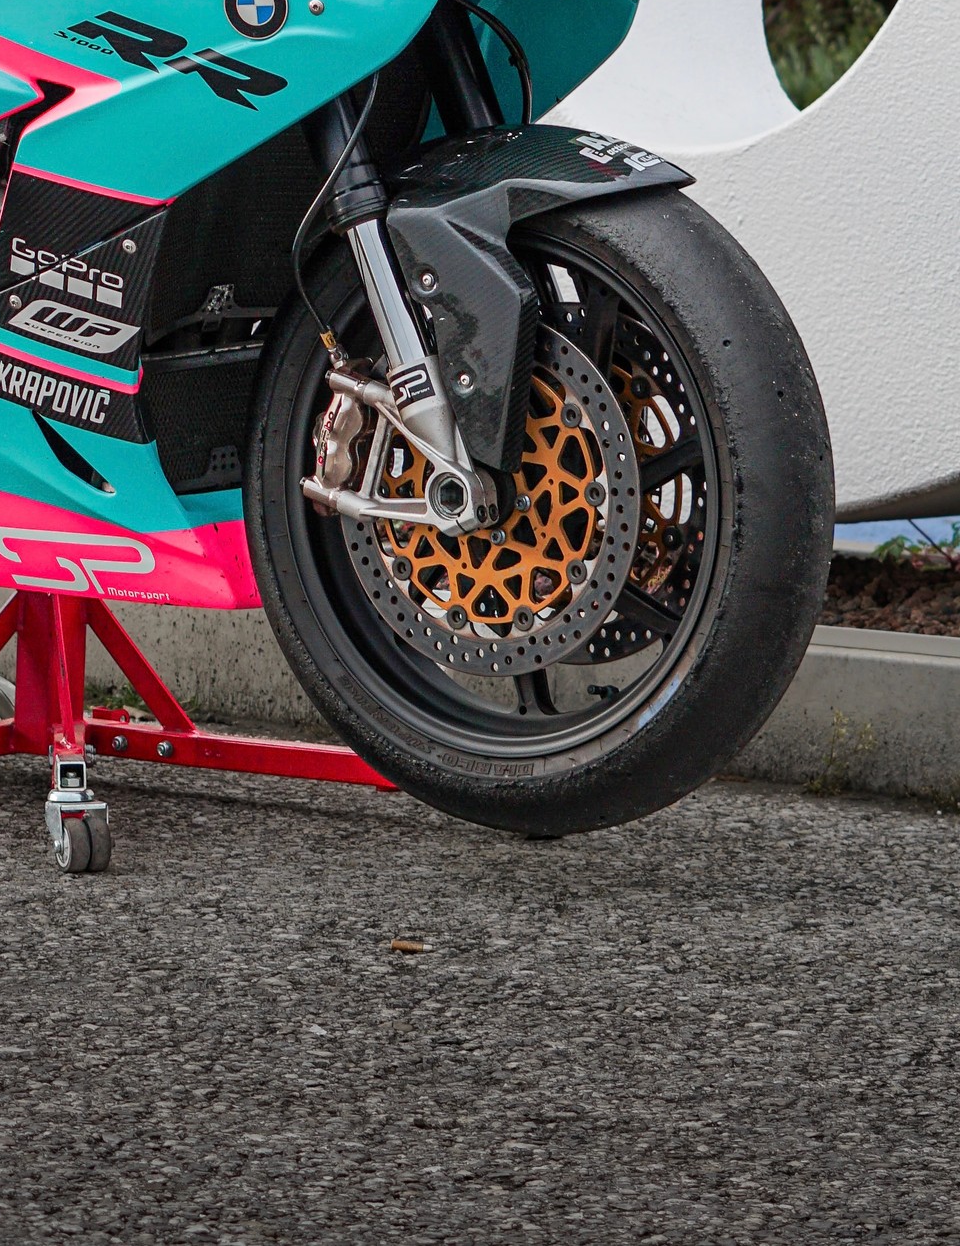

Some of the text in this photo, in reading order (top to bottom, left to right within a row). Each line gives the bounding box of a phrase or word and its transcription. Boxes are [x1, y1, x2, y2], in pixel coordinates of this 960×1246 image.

[53, 30, 115, 55] S1000
[67, 9, 289, 112] RR
[10, 237, 124, 289] GoPro
[30, 306, 123, 337] WP
[107, 586, 171, 601] Motorsport
